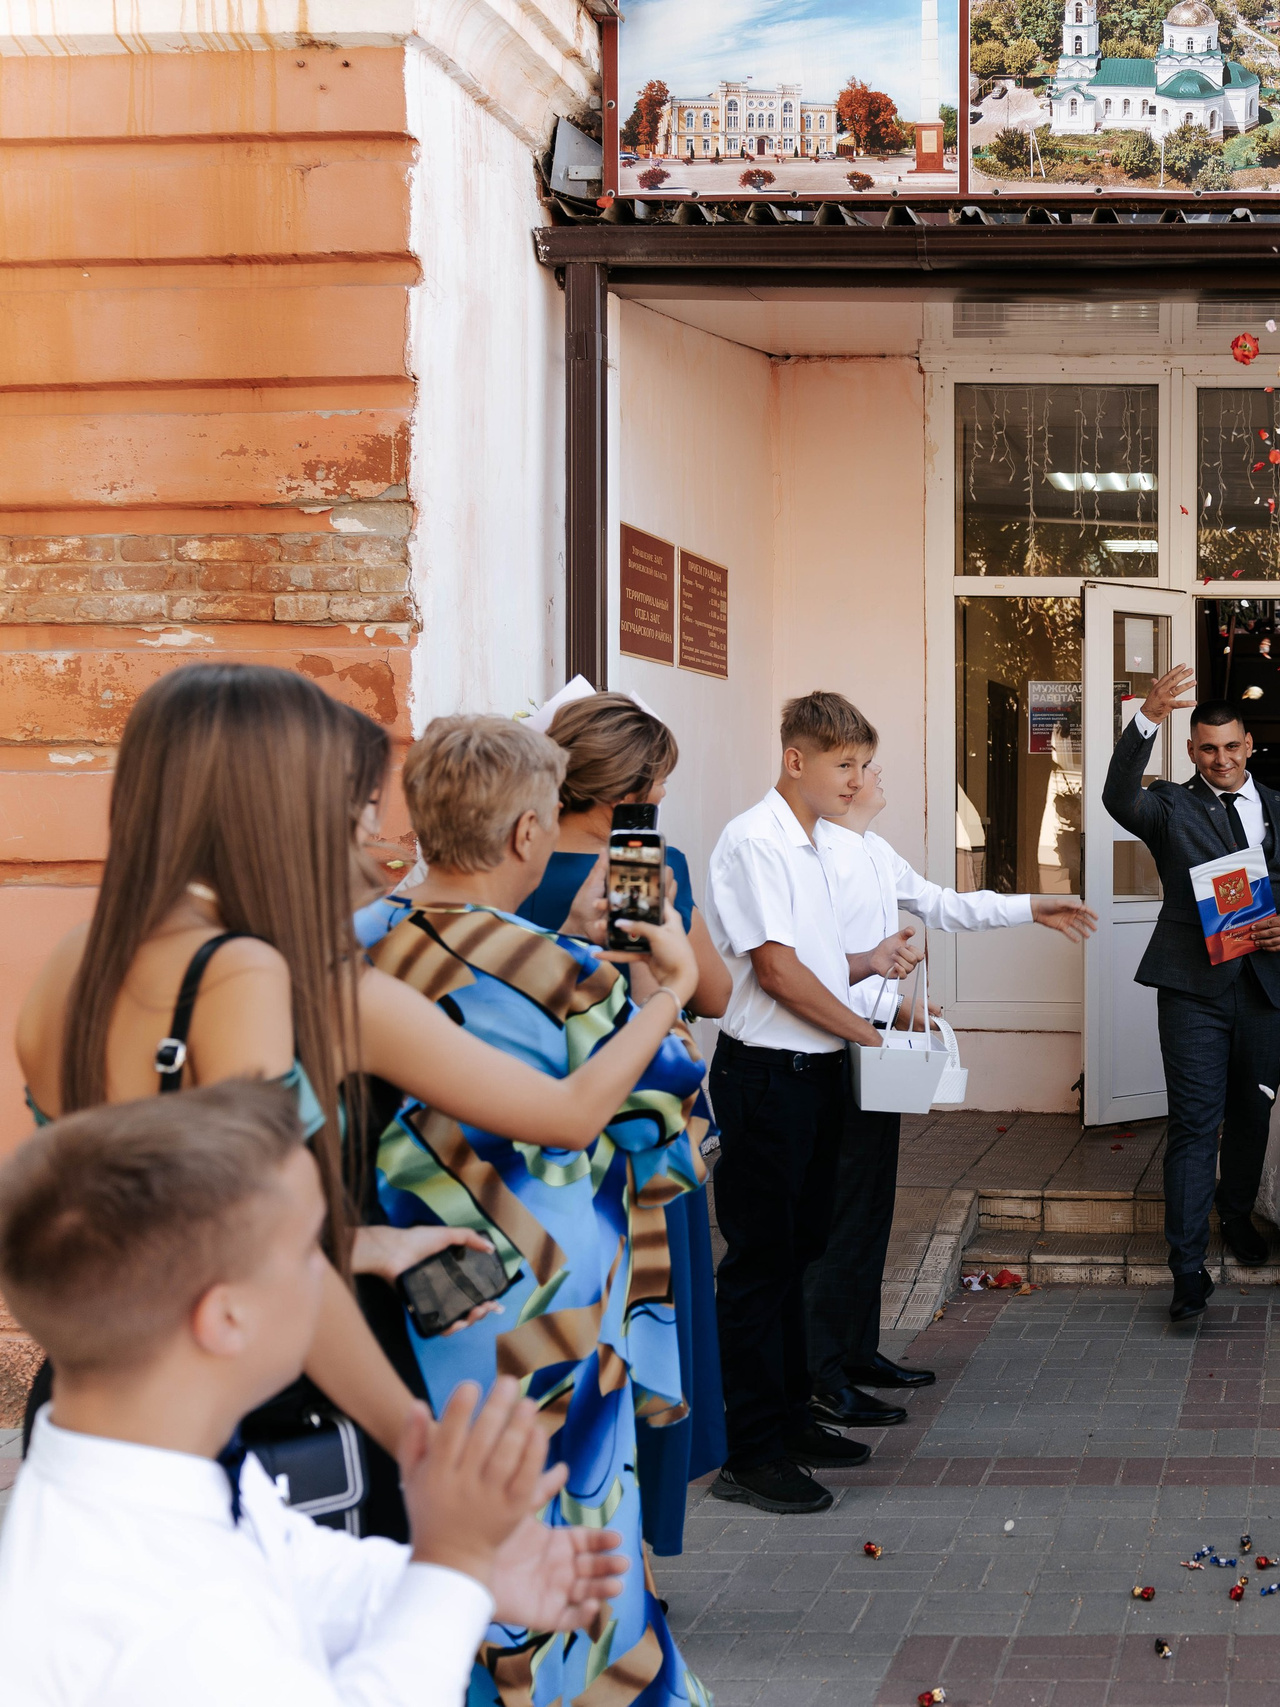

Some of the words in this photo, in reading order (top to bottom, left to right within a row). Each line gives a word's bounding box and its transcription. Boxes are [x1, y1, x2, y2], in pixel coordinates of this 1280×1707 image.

[626, 588, 669, 611] ТЕРРИТОРИАЛЬНЫЙ
[634, 607, 650, 621] ОТДЕЛ
[650, 612, 661, 625] ЗАГС
[621, 619, 655, 639] БОГУЧАРСКОГО
[654, 628, 673, 644] РАЙОНА
[1032, 694, 1075, 702] РАБОТА
